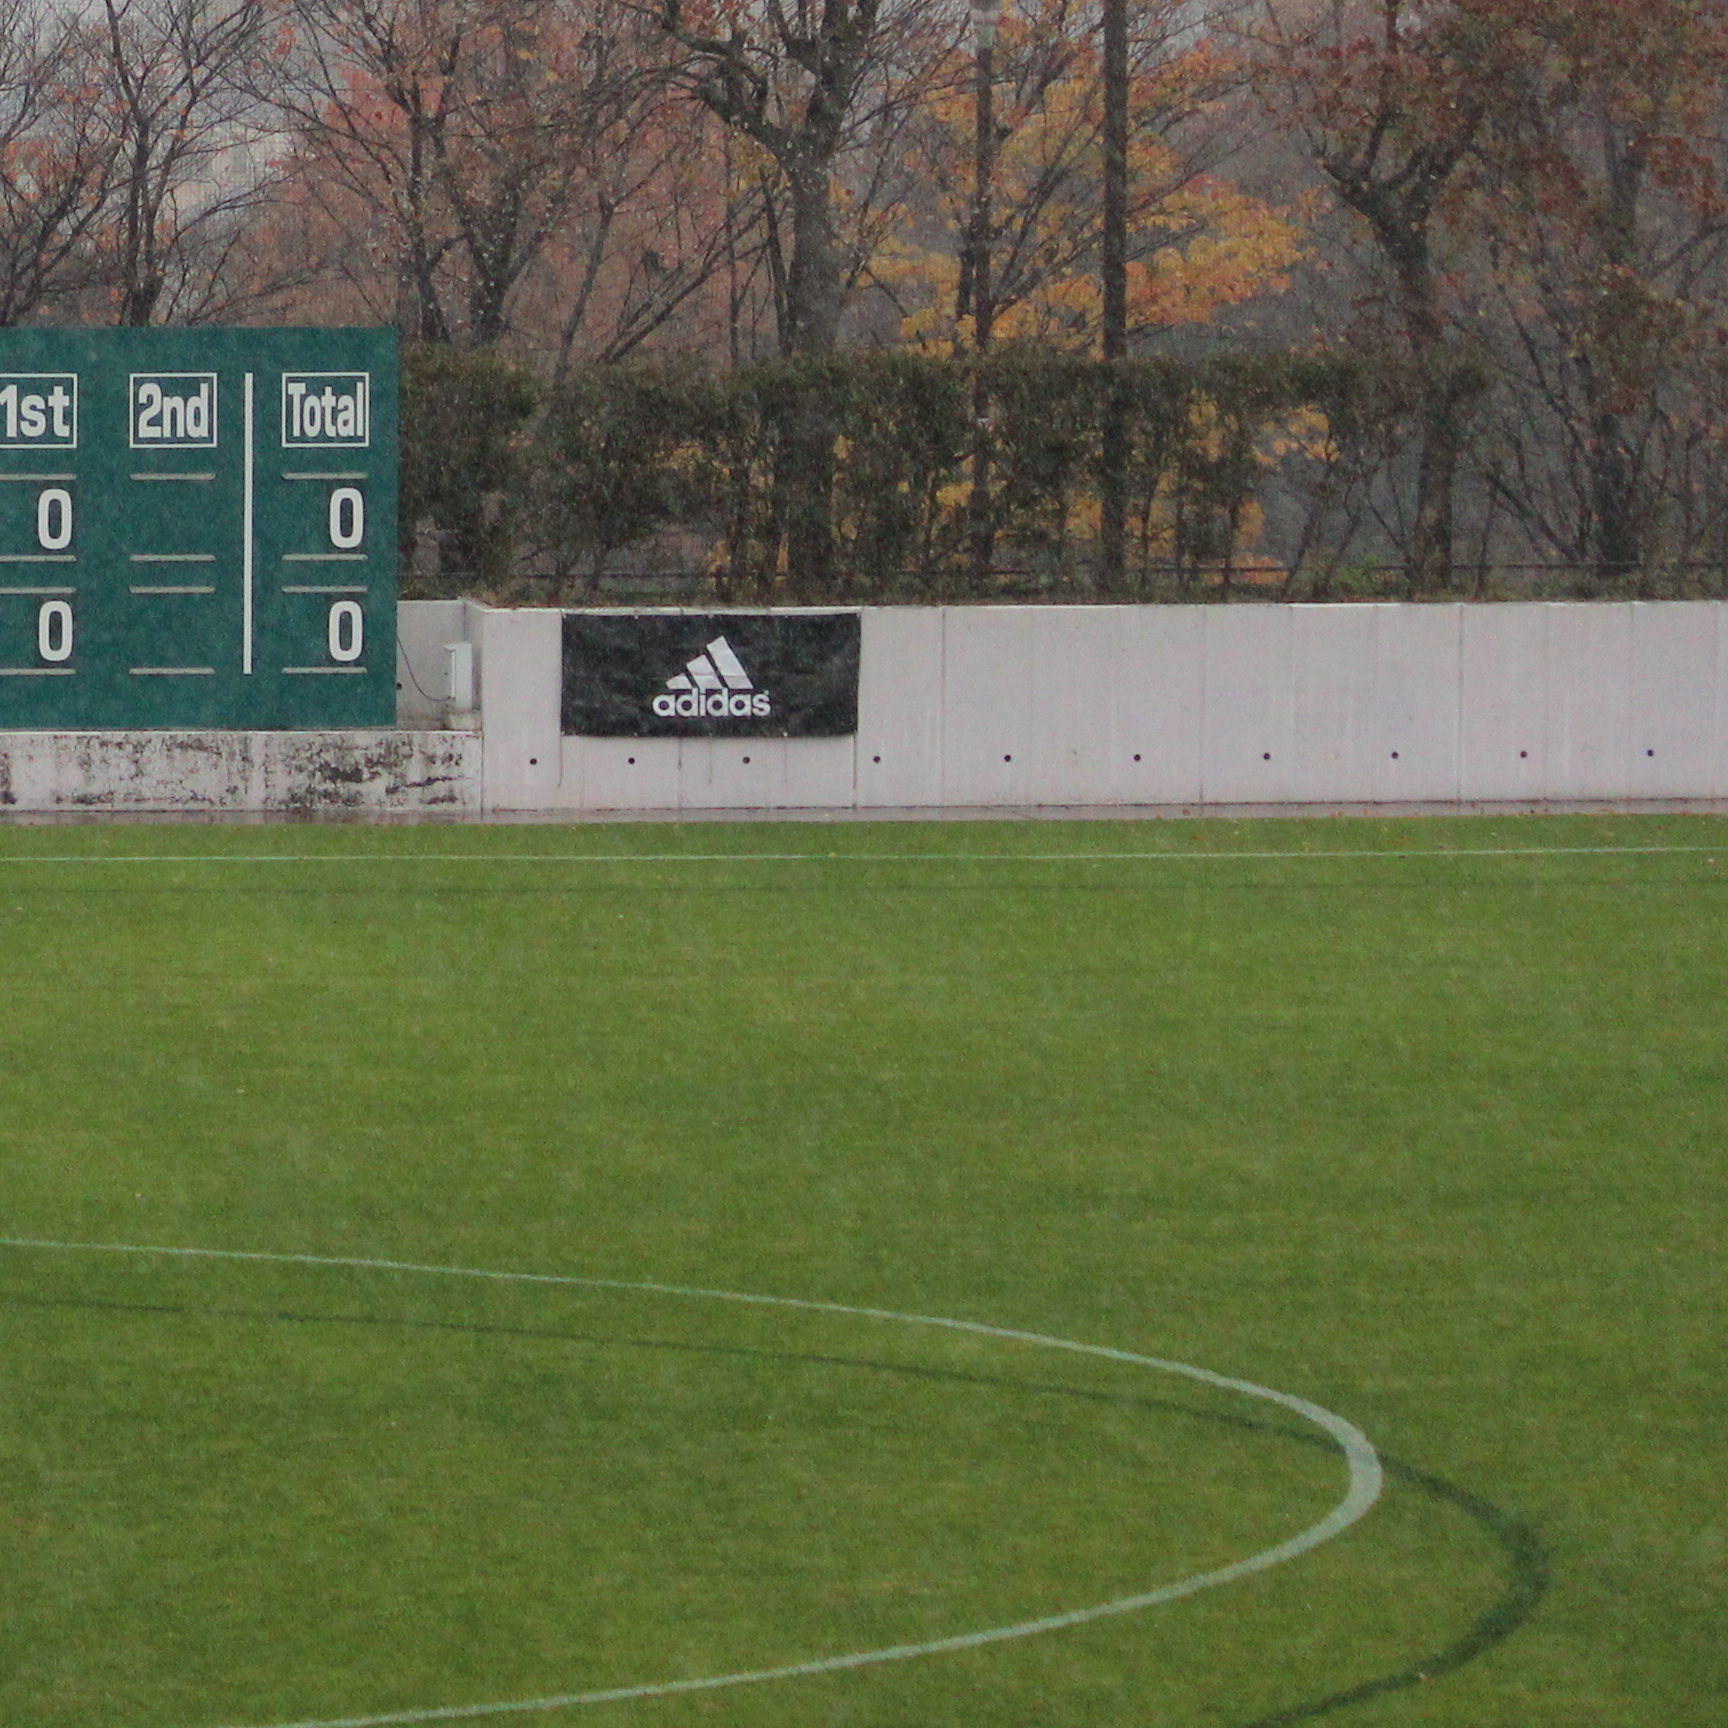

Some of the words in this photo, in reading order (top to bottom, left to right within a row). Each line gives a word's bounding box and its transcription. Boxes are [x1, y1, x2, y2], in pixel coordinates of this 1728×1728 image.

[137, 383, 210, 439] 2nd
[287, 381, 366, 439] Total
[37, 488, 73, 550] 0
[329, 487, 365, 549] 0
[37, 600, 73, 663] 0
[328, 600, 364, 663] 0
[652, 688, 771, 717] adidas
